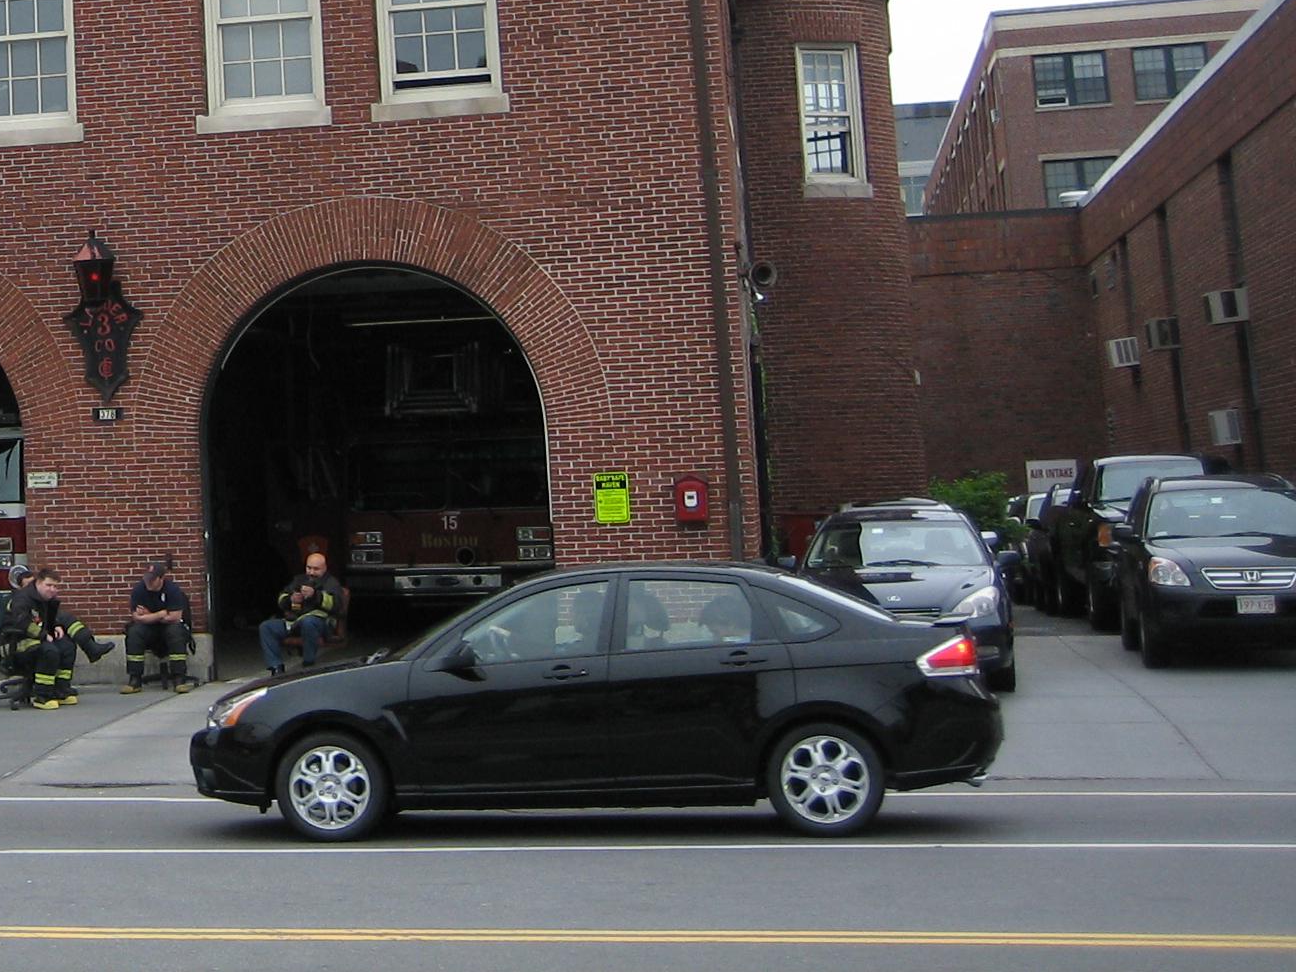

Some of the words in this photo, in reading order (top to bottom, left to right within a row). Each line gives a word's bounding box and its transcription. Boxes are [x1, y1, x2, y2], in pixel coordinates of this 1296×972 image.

[97, 313, 111, 336] 3
[1030, 468, 1044, 479] AIR
[1045, 467, 1074, 478] INTAKE
[441, 515, 458, 530] 15
[421, 533, 479, 548] Boston
